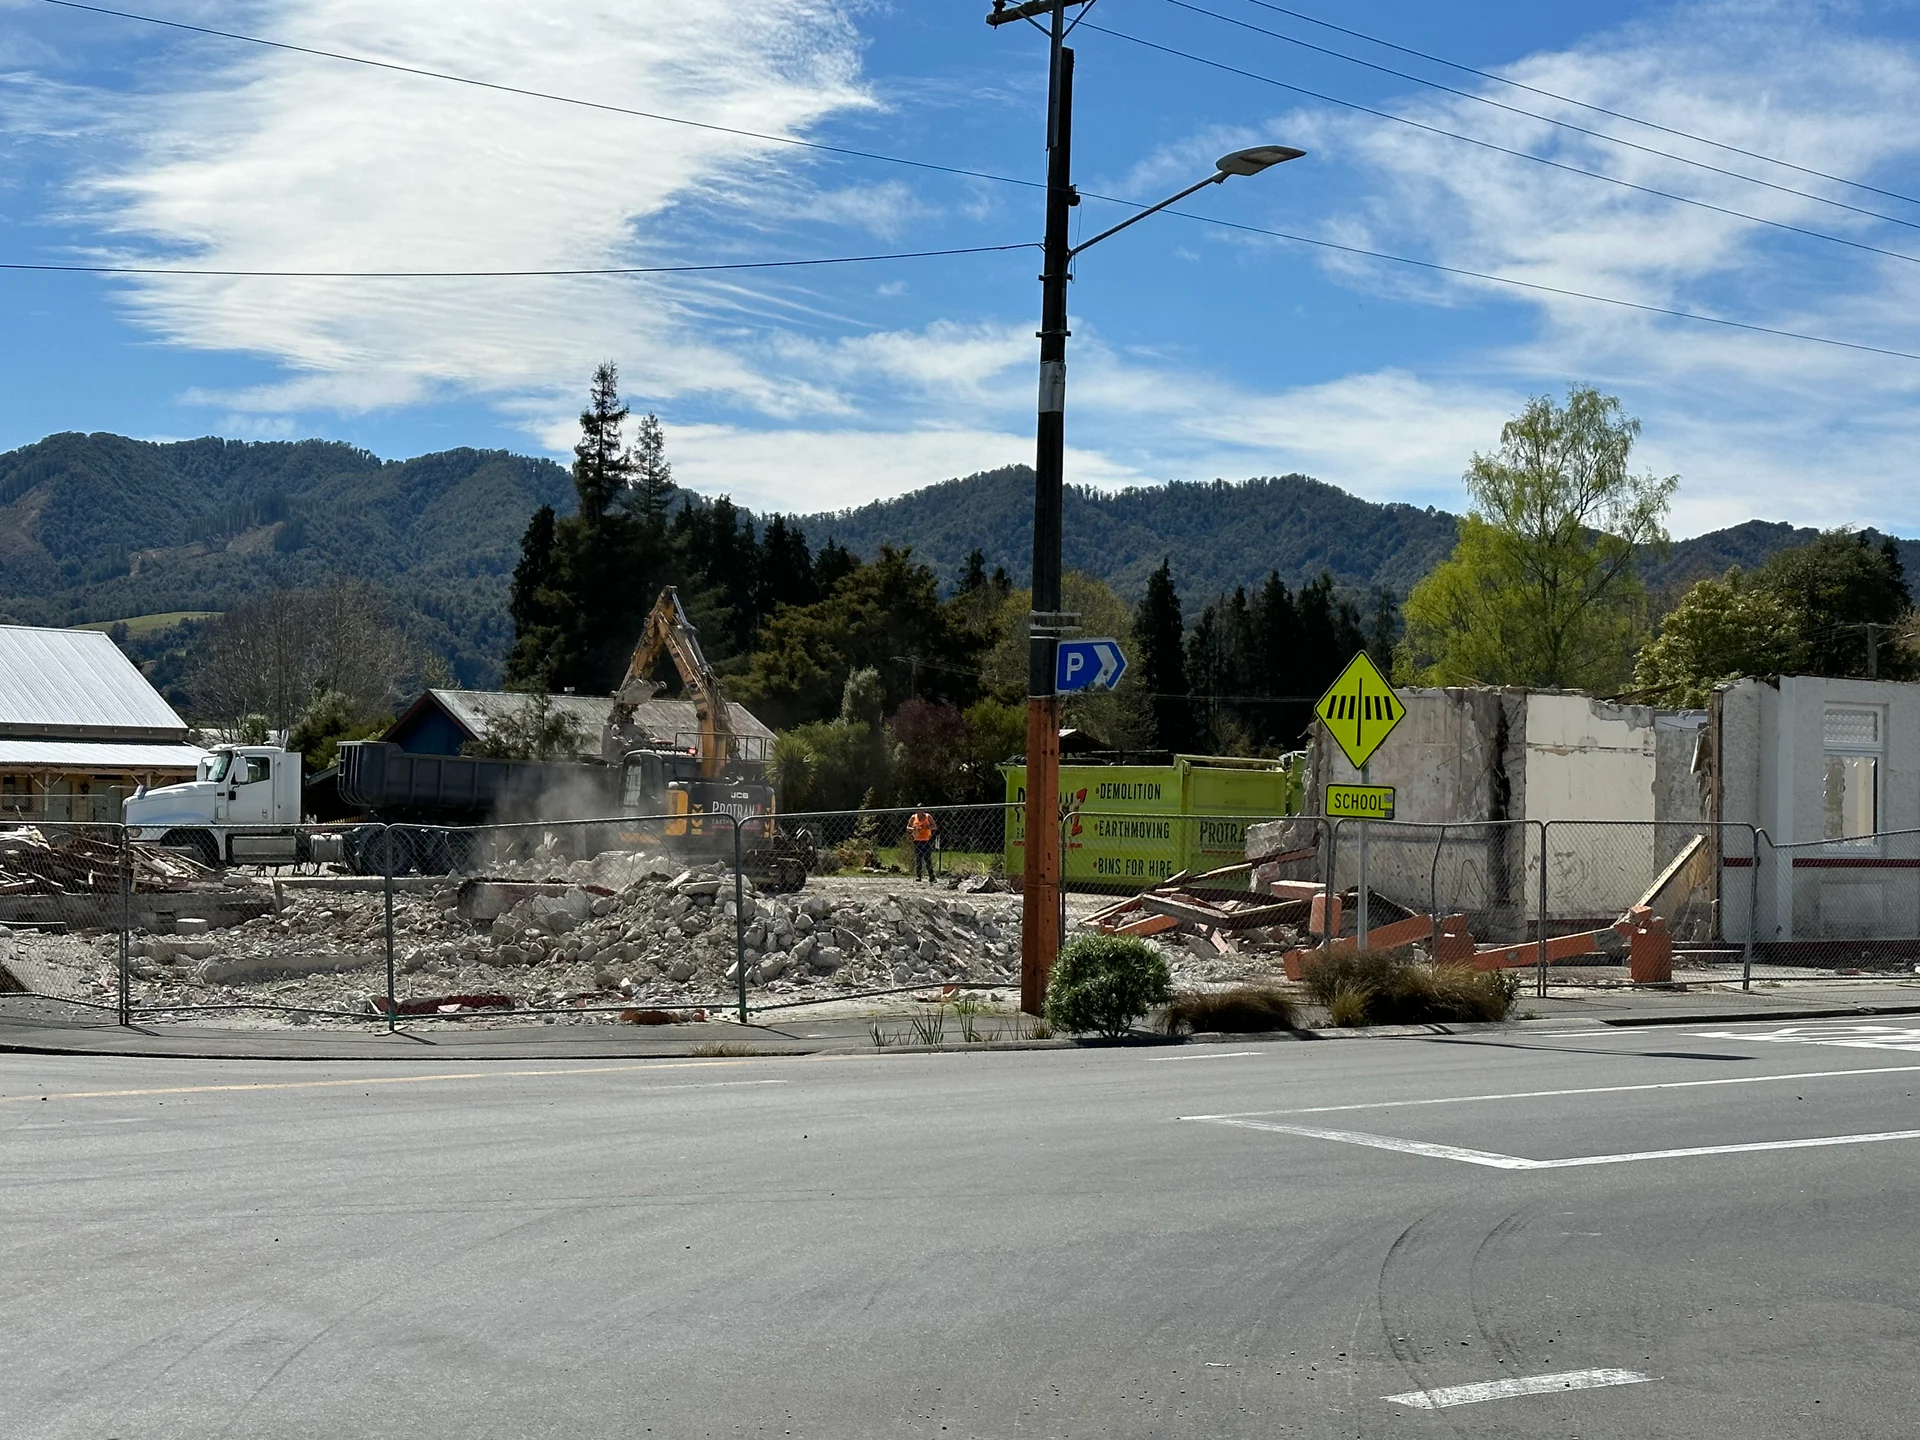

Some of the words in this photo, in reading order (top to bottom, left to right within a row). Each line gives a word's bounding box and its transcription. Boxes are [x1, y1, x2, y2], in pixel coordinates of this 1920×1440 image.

[1066, 652, 1084, 682] P
[1100, 783, 1161, 800] DEMOLITION
[1334, 793, 1385, 811] SCHOOL
[1099, 820, 1170, 839] EARTHMOVING
[1098, 858, 1121, 874] BINS
[1125, 859, 1144, 876] FOR
[1149, 860, 1172, 878] HIRE
